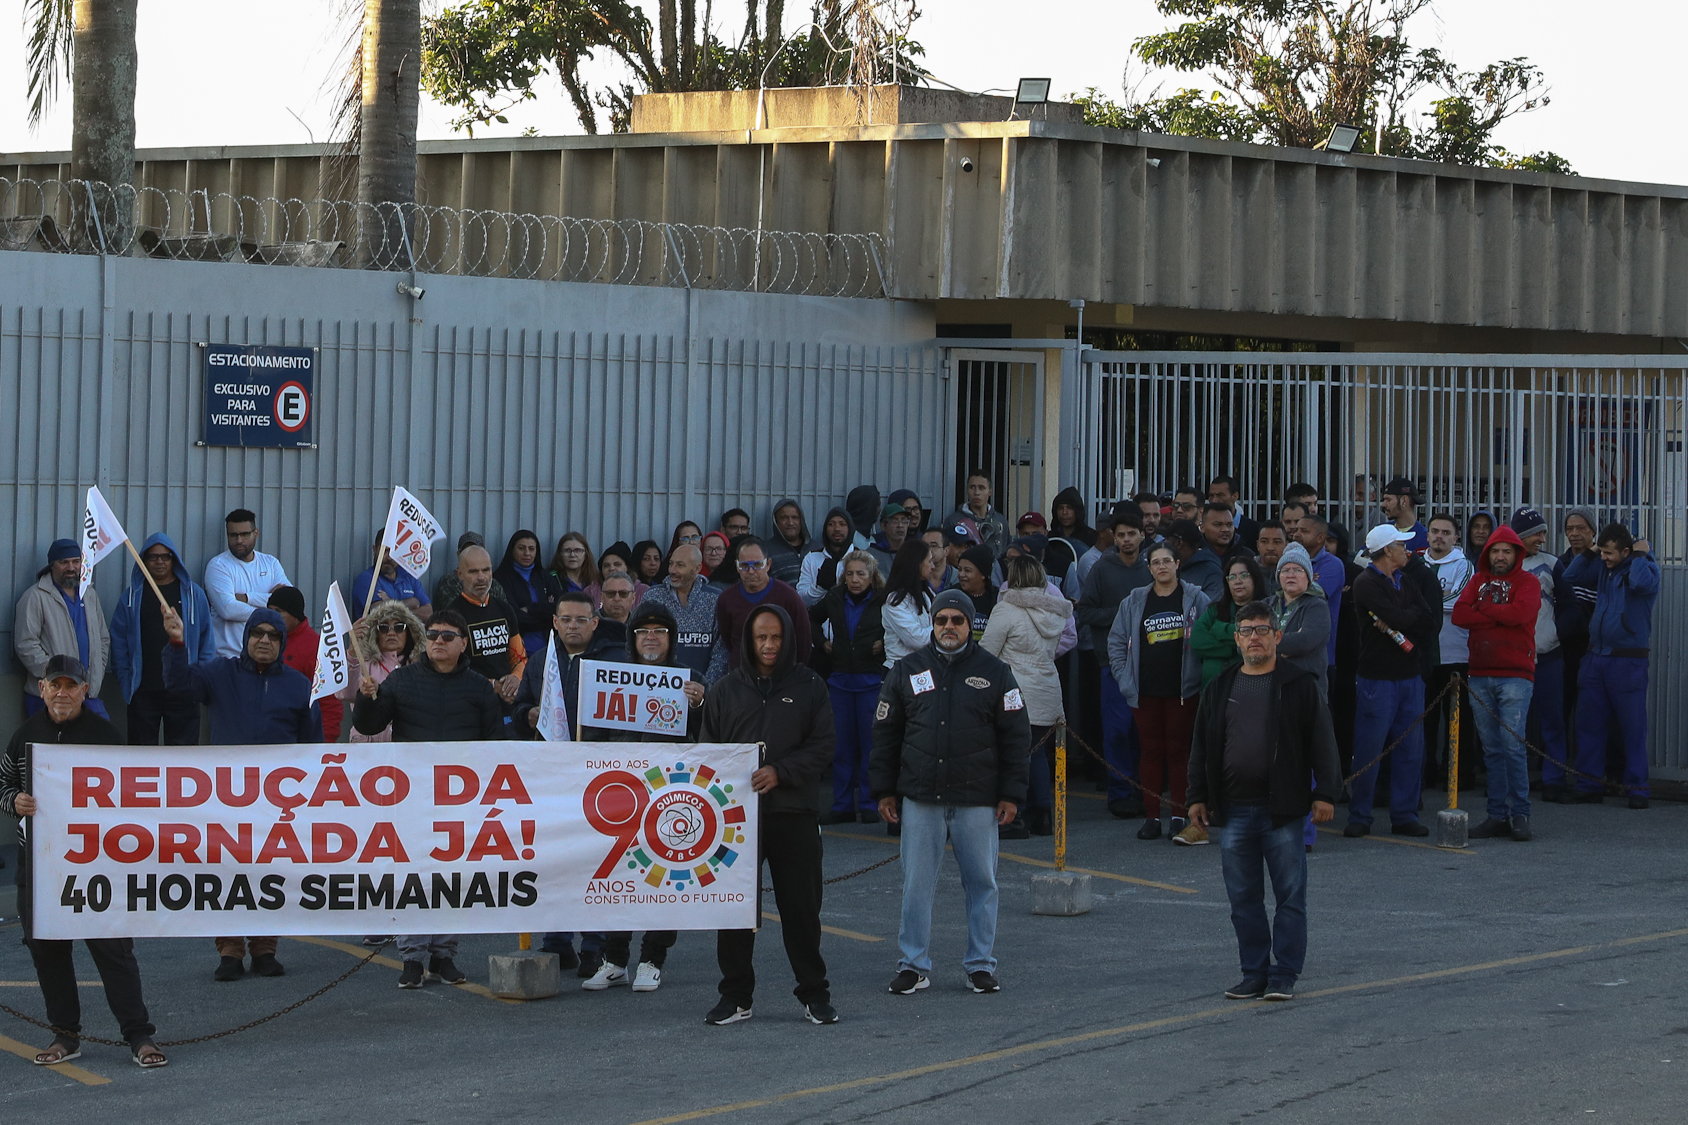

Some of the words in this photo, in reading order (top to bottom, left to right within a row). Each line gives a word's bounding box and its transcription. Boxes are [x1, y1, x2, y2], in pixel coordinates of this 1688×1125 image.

[209, 353, 311, 369] ESTACIONAMENTO
[214, 383, 271, 396] EXCLUSIVO
[227, 399, 256, 411] PARA
[283, 392, 300, 420] E
[211, 413, 271, 427] VISITANTES
[400, 498, 437, 540] REDUÇÃO
[1143, 614, 1184, 627] Carnaval
[472, 624, 508, 640] BLACK
[321, 609, 345, 685] EDUÇÃO
[475, 634, 509, 650] FRIDAY
[595, 668, 683, 691] REDUÇÃO
[593, 687, 638, 722] JÁ!
[586, 760, 621, 769] RUMO
[626, 759, 649, 769] AOS
[72, 753, 411, 822] REDUÇÃO
[433, 764, 533, 806] DA
[656, 792, 705, 811] QUÍMICOS
[64, 822, 411, 864] JORNADA
[429, 807, 536, 862] JÁ!
[60, 874, 112, 913] 40
[127, 873, 286, 912] HORAS
[299, 871, 538, 911] SEMANAIS
[586, 880, 636, 893] ANOS
[584, 894, 677, 904] CONSTRUINDO
[681, 893, 690, 903] O
[693, 893, 745, 903] FUTURO
